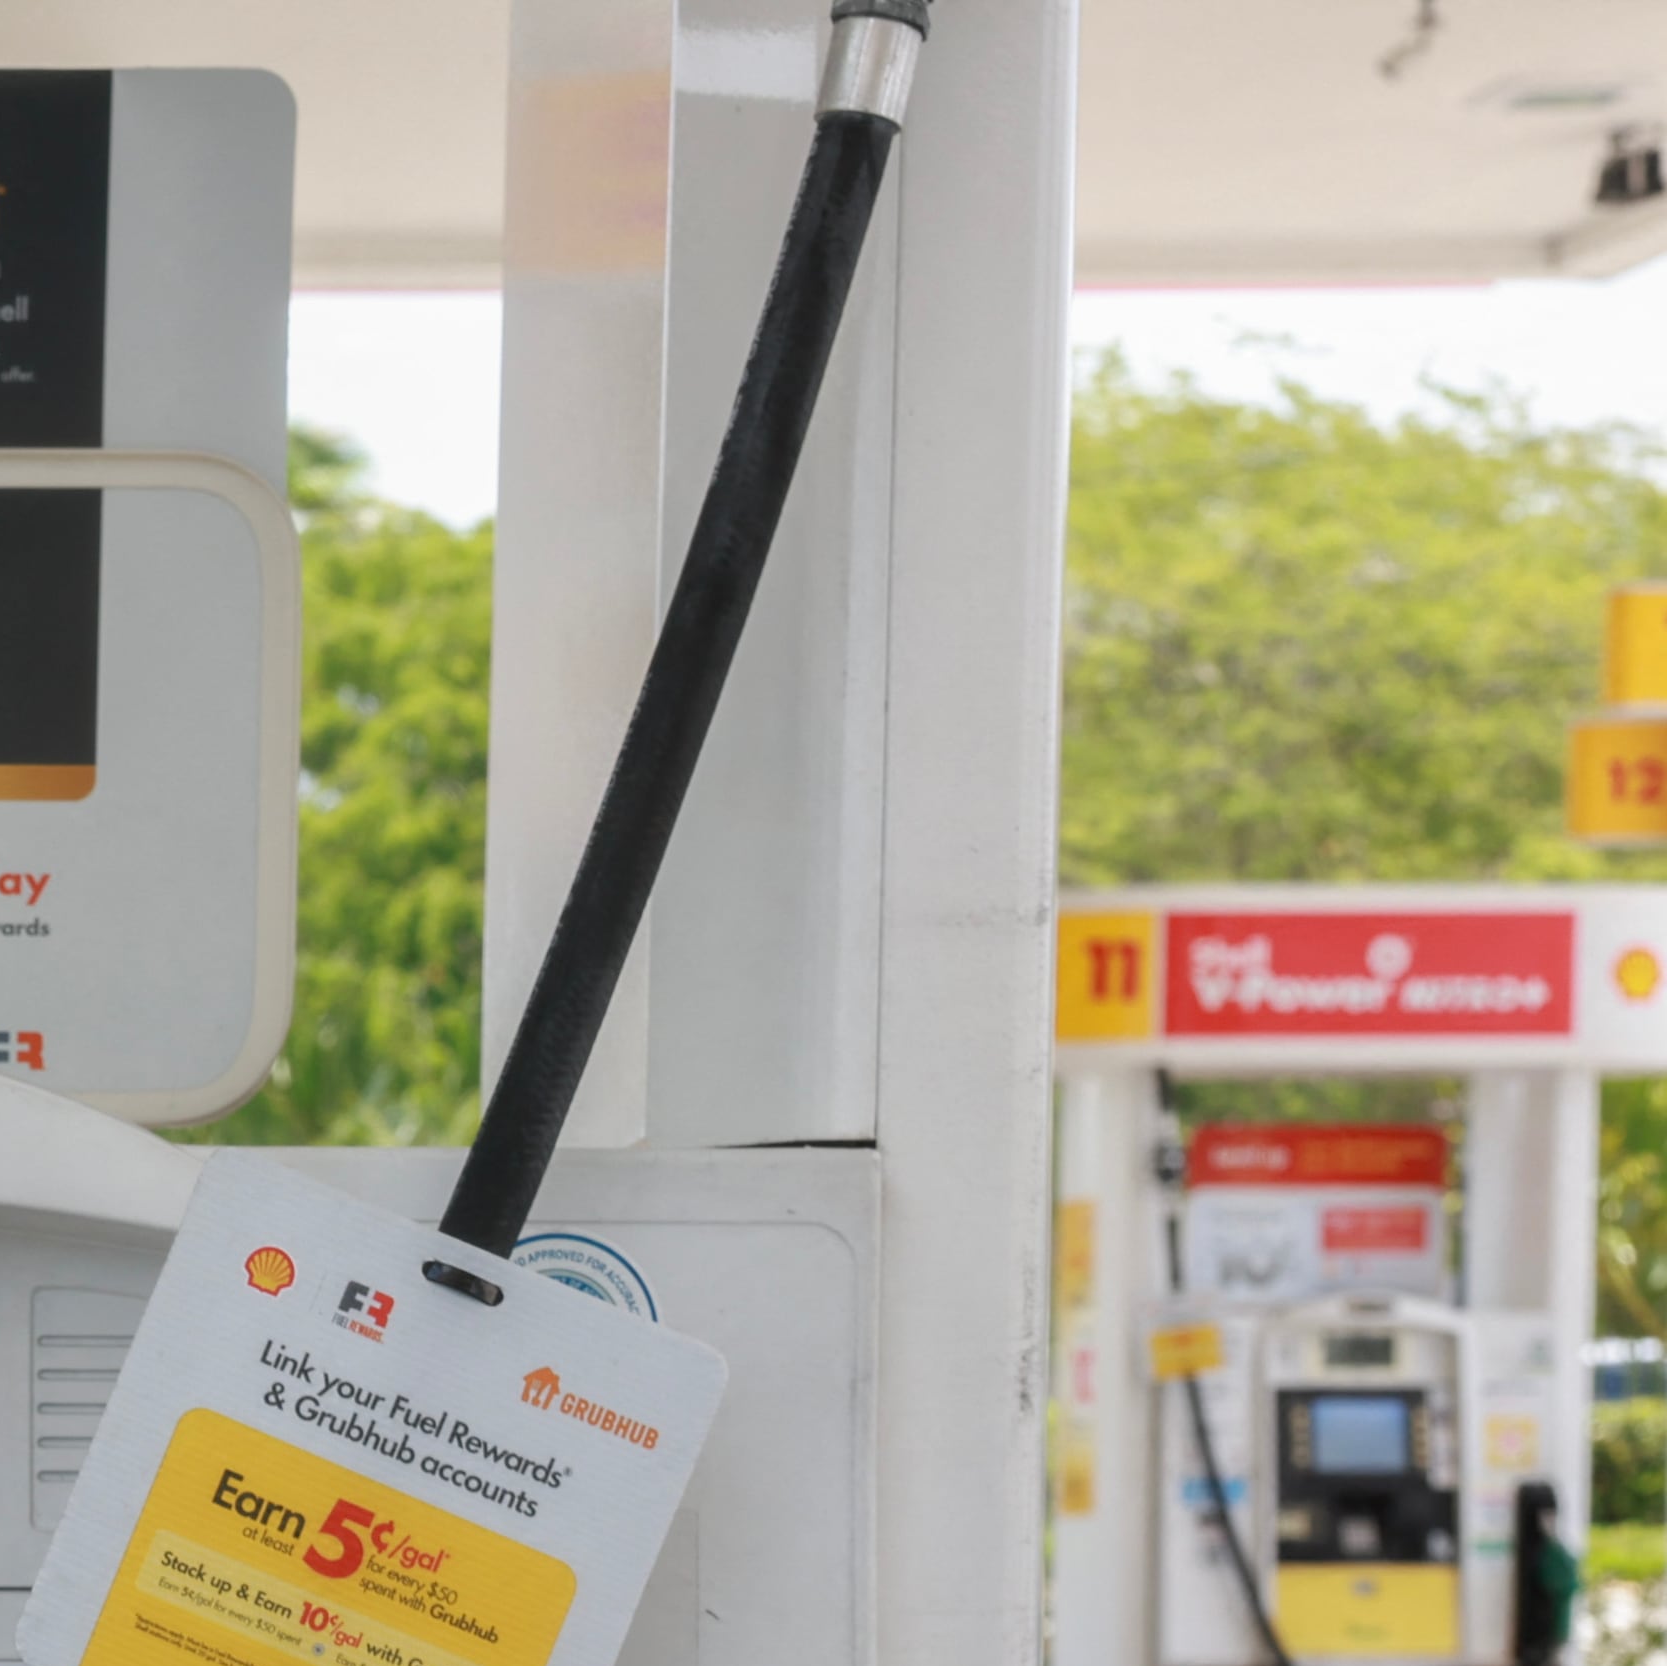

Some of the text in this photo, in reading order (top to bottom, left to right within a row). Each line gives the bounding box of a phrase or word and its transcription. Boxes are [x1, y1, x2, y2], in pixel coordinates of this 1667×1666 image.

[1086, 938, 1139, 1003] 11
[528, 1249, 585, 1265] APPROVED
[331, 1314, 351, 1331] FUEL
[259, 1338, 315, 1384] Link
[316, 1371, 386, 1411] your
[388, 1393, 448, 1438] Fuel
[262, 1381, 538, 1518] & Grubhub accounts
[560, 1393, 660, 1450] GRUBHUB
[212, 1468, 306, 1540] Earn
[242, 1525, 295, 1557] at least
[160, 1550, 206, 1583] Stack
[209, 1572, 232, 1596] up
[235, 1582, 249, 1601] &
[253, 1590, 293, 1621] Earn
[358, 1576, 499, 1645] spent with Grubhub
[366, 1552, 459, 1606] for every $50
